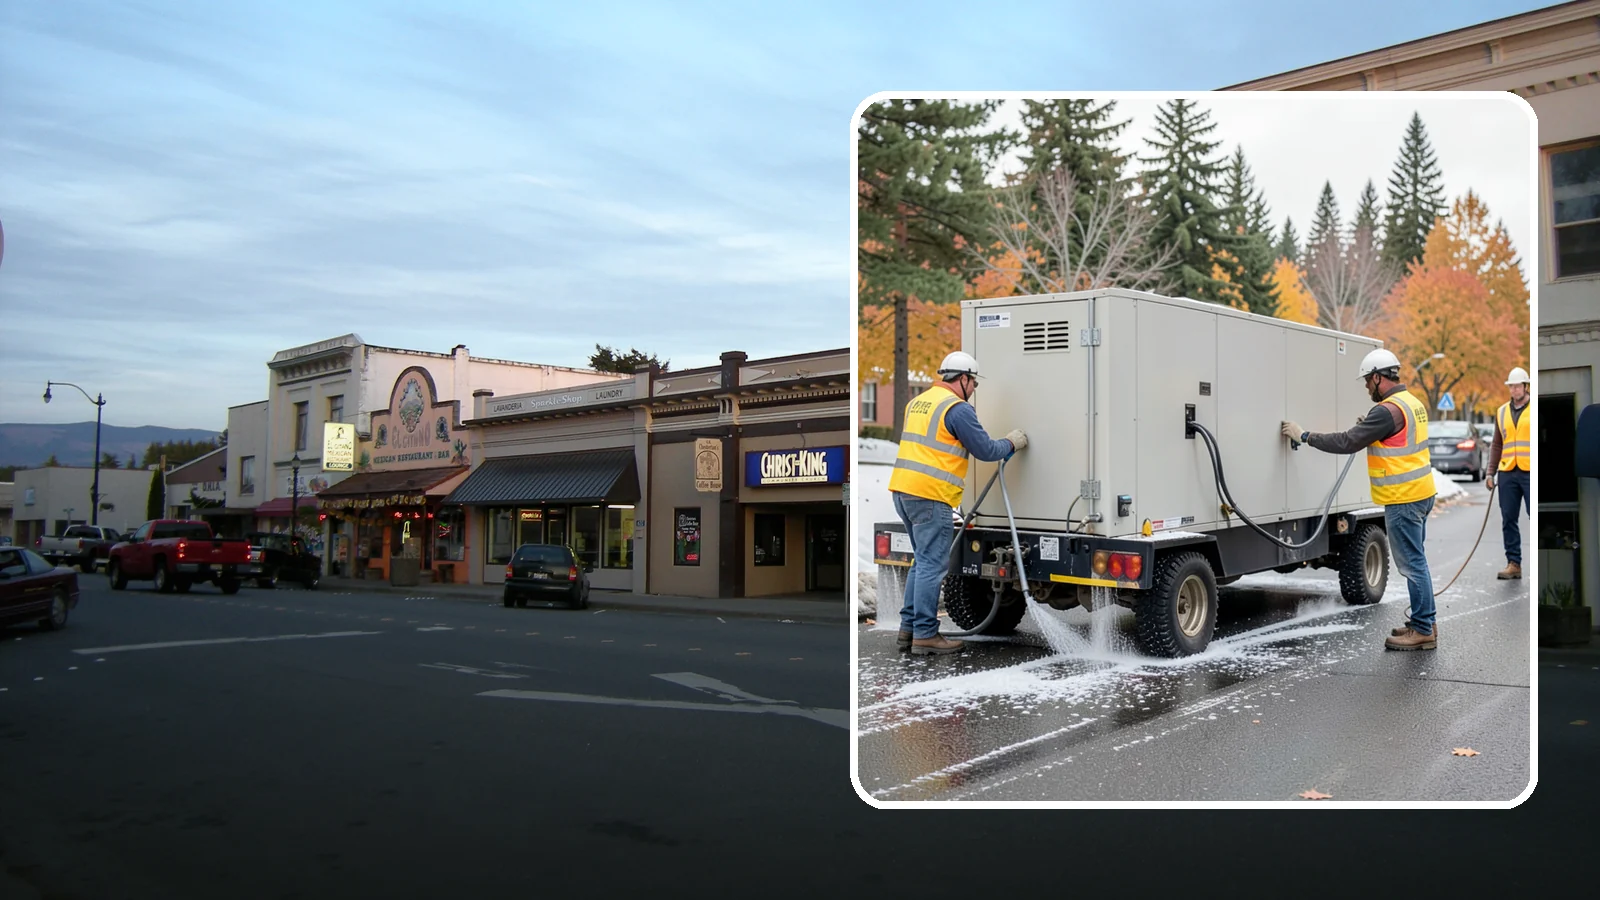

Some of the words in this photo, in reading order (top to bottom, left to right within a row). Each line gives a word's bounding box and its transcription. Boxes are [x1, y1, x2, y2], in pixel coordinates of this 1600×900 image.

[562, 394, 582, 405] Shop
[596, 389, 623, 400] LAUNDRY
[493, 402, 522, 412] LAVANDERIA
[392, 425, 401, 449] EL
[373, 454, 396, 464] MEXICAN
[398, 451, 433, 462] RESTAURANT
[438, 450, 450, 459] BAR
[761, 452, 797, 478] CHRIST
[799, 450, 827, 476] KING
[697, 481, 709, 489] Coffee
[710, 481, 721, 489] House
